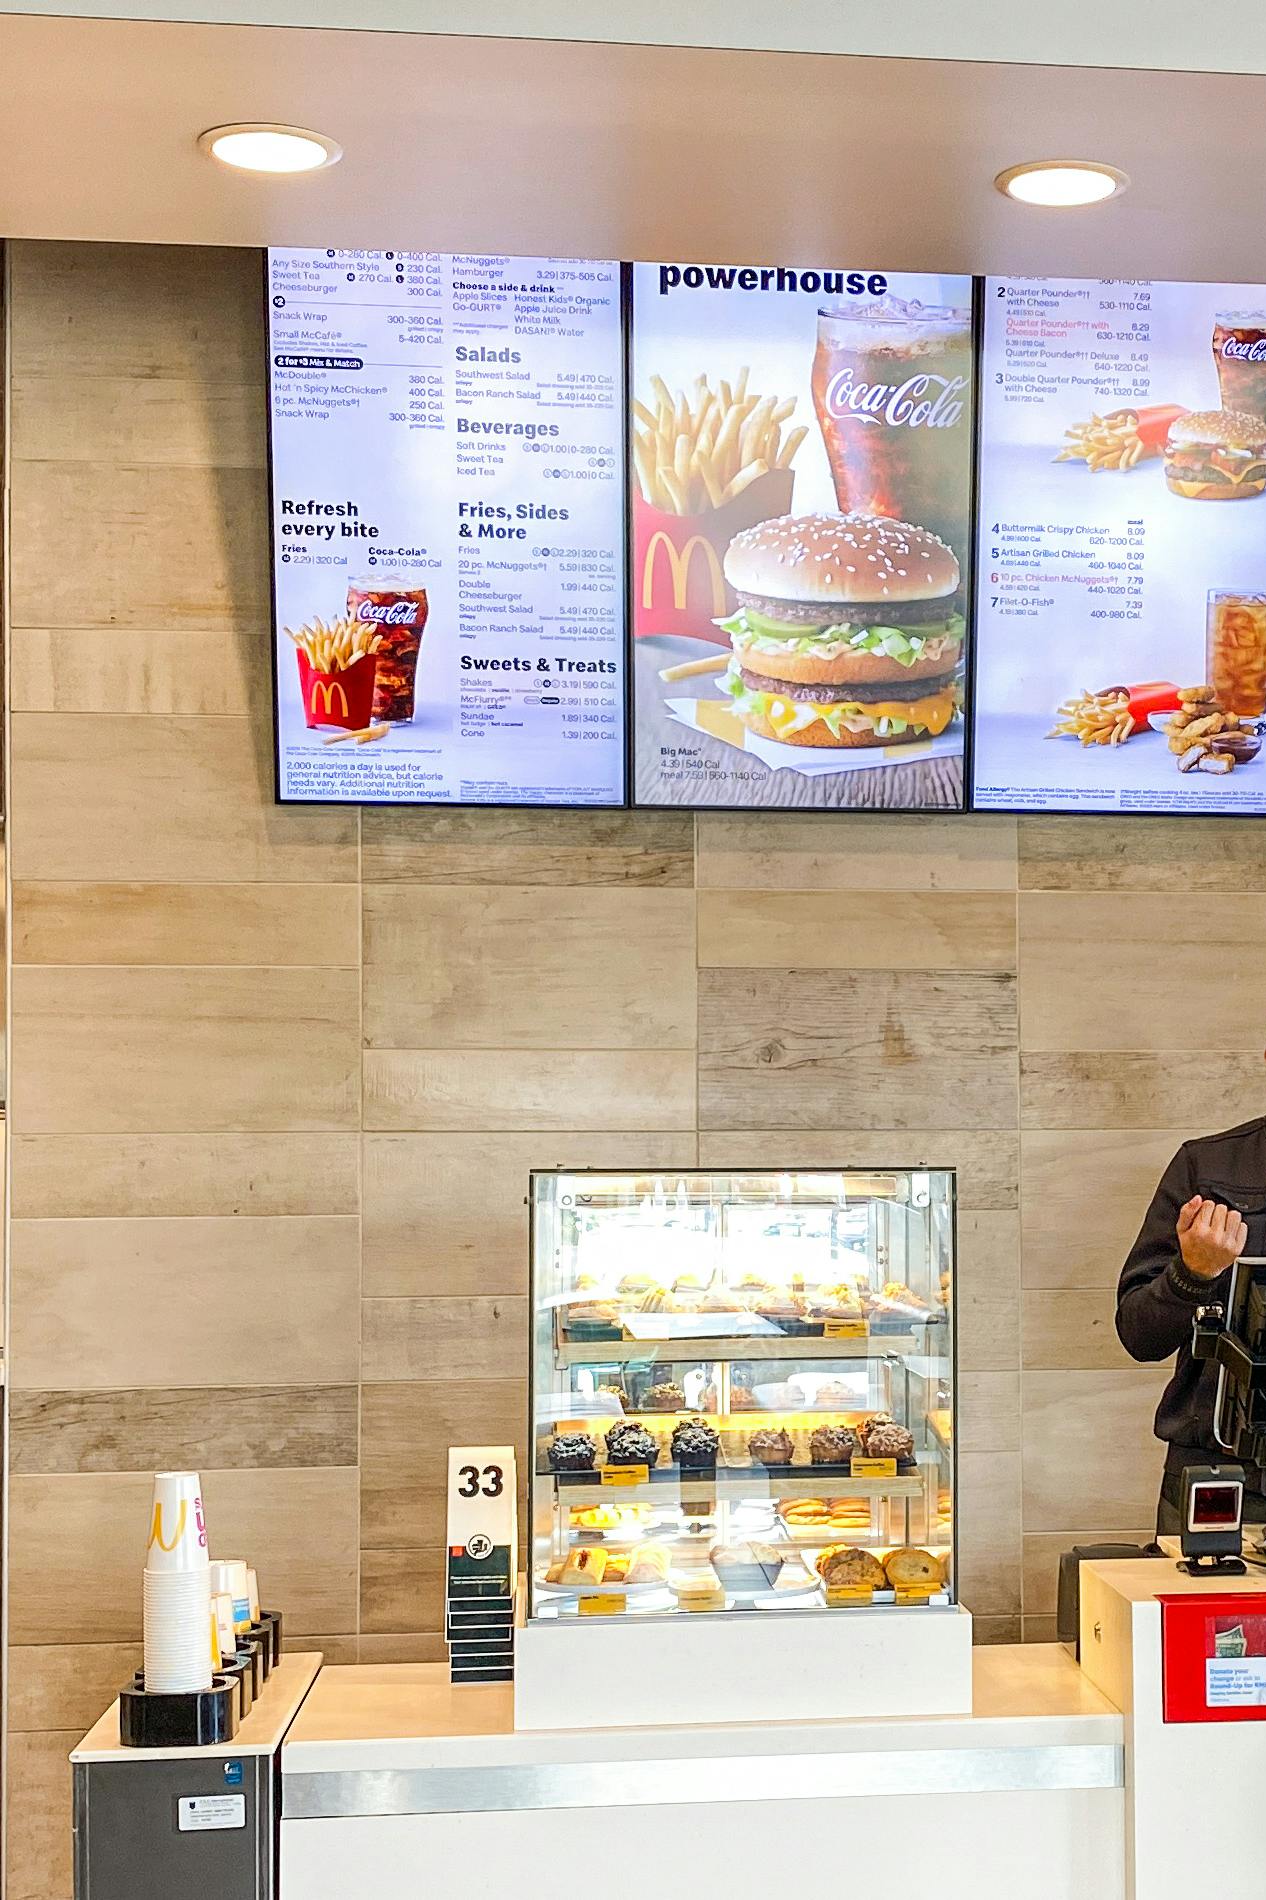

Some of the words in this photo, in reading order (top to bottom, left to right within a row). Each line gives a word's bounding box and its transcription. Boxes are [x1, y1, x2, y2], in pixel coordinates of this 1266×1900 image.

[452, 268, 504, 278] Hamburger
[660, 265, 888, 295] powerhouse
[272, 283, 337, 294] Cheeseburger
[453, 282, 488, 290] Choose
[498, 284, 518, 292] side
[453, 292, 478, 300] Apple
[481, 293, 507, 301] Slices
[998, 287, 1005, 298] 2
[1007, 288, 1040, 297] Quarter
[575, 296, 610, 306] Organic
[1007, 298, 1024, 306] with
[1027, 298, 1059, 307] Cheese
[514, 305, 540, 314] Apple
[542, 305, 567, 313] Juice
[569, 306, 592, 314] Drink
[273, 311, 301, 320] Snack
[303, 312, 327, 322] Wrap
[1007, 318, 1039, 328] Quarter
[1006, 328, 1039, 336] Cheese
[1041, 329, 1067, 337] Bacon
[456, 346, 521, 363] Salads
[1006, 349, 1038, 359] Quarter
[1090, 352, 1119, 360] Deluxe
[334, 360, 360, 368] Match
[995, 373, 1003, 384] 3
[1005, 374, 1035, 382] Double
[1038, 375, 1069, 385] Quarter
[304, 385, 328, 394] Spicy
[1025, 385, 1057, 393] Cheese
[275, 409, 303, 418] Snack
[306, 410, 329, 420] Wrap
[457, 418, 559, 439] Beverages
[457, 442, 475, 450] Soft
[282, 500, 358, 516] Refresh
[458, 502, 512, 521] Fries,
[516, 504, 569, 520] Sides
[282, 524, 335, 540] every
[341, 522, 379, 537] bite
[459, 523, 472, 538] &
[478, 524, 527, 539] More
[992, 523, 999, 534] 4
[1002, 524, 1045, 532] Buttermilk
[1048, 525, 1073, 535] Crispy
[1076, 526, 1109, 534] Chicken
[458, 546, 480, 554] Fries
[992, 548, 999, 558] 5
[1033, 550, 1059, 558] Grilled
[991, 573, 998, 583] 6
[459, 580, 490, 588] Double
[459, 591, 522, 601] Cheeseburger
[991, 597, 998, 607] 7
[459, 604, 507, 612] Southwest
[509, 605, 533, 613] Salad
[460, 624, 487, 632] Bacon
[519, 625, 543, 633] Salad
[461, 656, 531, 671] Sweets
[537, 658, 550, 671] &
[555, 658, 617, 673] Treats
[460, 678, 492, 686] Shakes
[461, 712, 494, 720] Sundae
[661, 748, 676, 756] Big
[313, 762, 348, 771] calories
[358, 763, 373, 772] day
[396, 772, 410, 780] but
[351, 788, 391, 796] available
[393, 790, 414, 798] upon
[458, 1466, 503, 1497] 33
